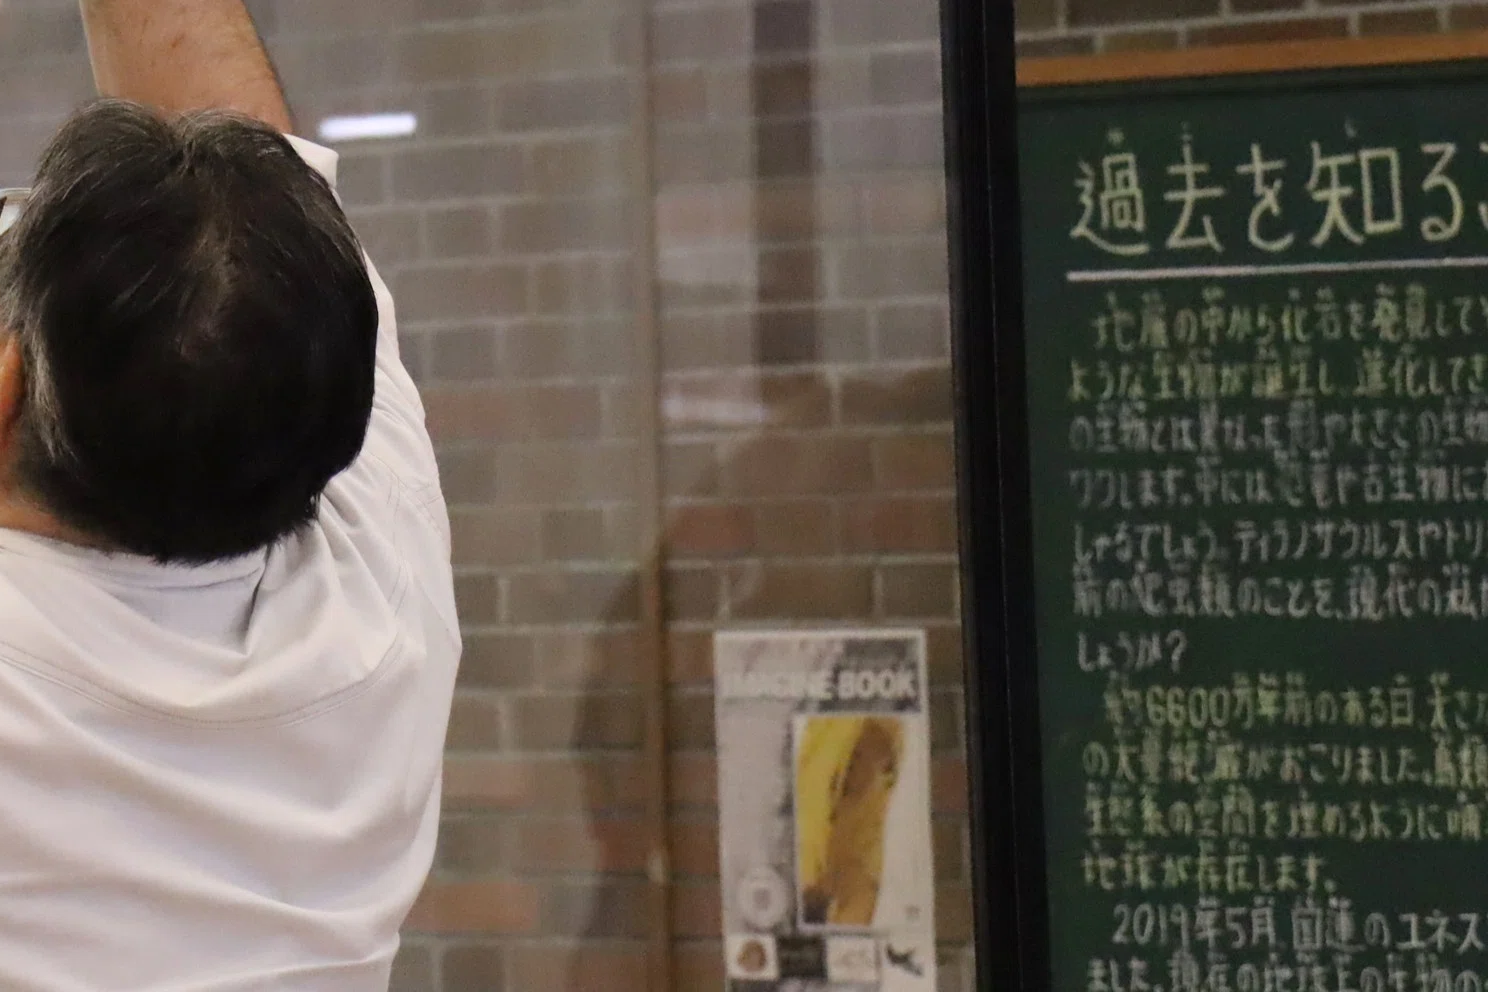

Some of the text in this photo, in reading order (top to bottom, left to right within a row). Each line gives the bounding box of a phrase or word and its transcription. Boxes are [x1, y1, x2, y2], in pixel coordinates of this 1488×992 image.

[1069, 141, 1488, 256] 過去を知る
[839, 669, 917, 700] BOOK
